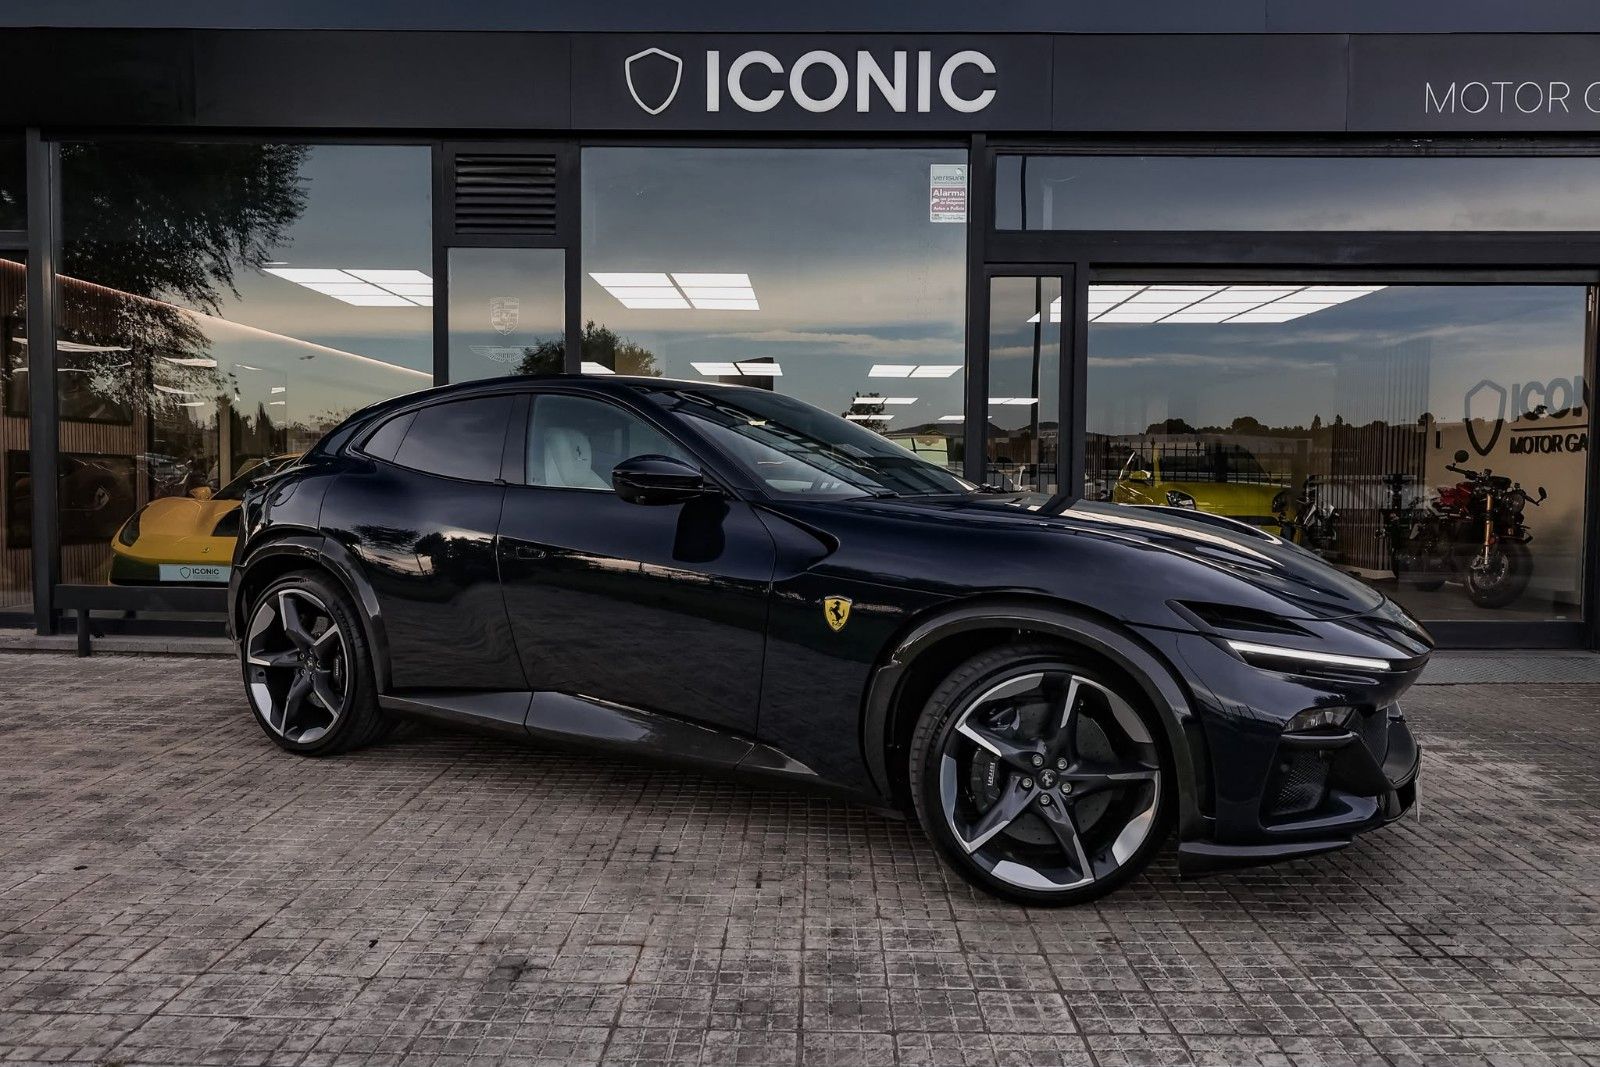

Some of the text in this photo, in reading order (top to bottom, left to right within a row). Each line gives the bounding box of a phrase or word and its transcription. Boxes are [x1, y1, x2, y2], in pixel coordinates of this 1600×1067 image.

[706, 50, 997, 113] ICONIC
[1425, 81, 1570, 114] MOTOR
[933, 188, 965, 197] Alarma
[1509, 434, 1563, 454] MOTOR
